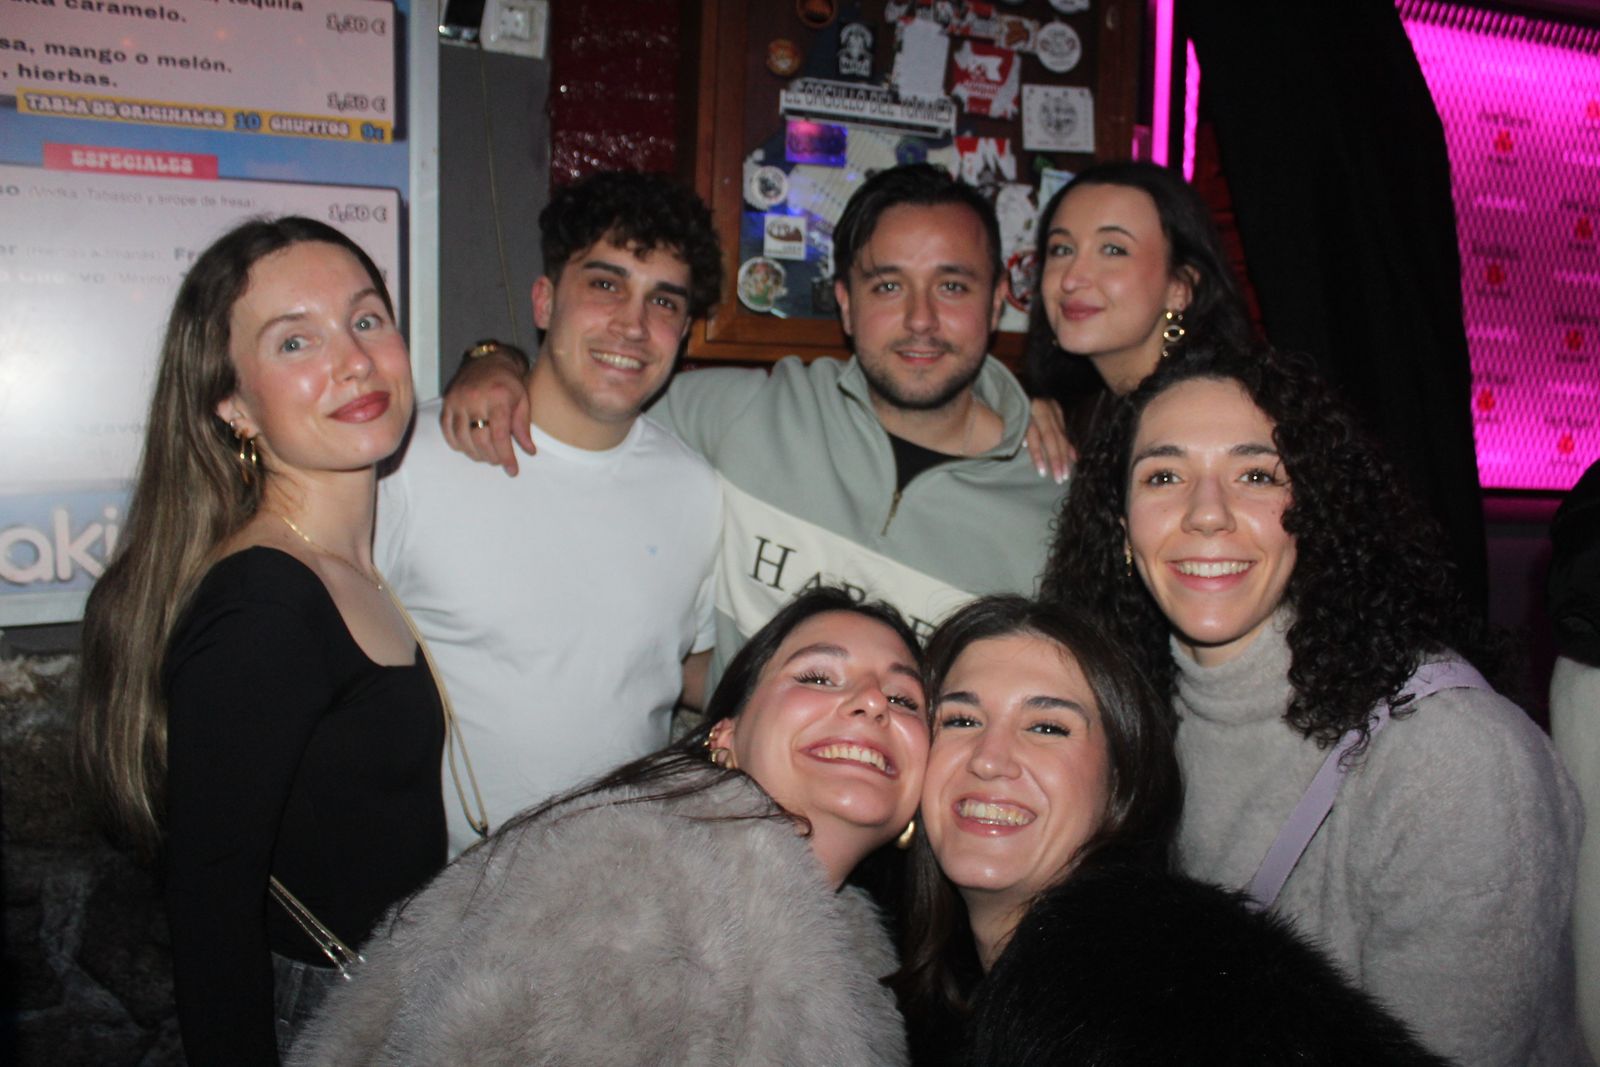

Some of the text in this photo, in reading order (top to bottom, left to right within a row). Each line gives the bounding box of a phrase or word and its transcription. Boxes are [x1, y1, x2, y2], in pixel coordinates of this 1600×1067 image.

[65, 0, 187, 22] caramelo.
[44, 41, 127, 65] mango
[135, 52, 149, 64] o
[157, 54, 232, 74] melón.
[17, 63, 118, 87] hierbas.
[25, 93, 89, 115] TABLA
[91, 99, 116, 117] DE
[118, 103, 227, 127] ORIGINALES
[270, 115, 350, 137] CHUPITOS
[70, 149, 194, 175] ESPECIALES
